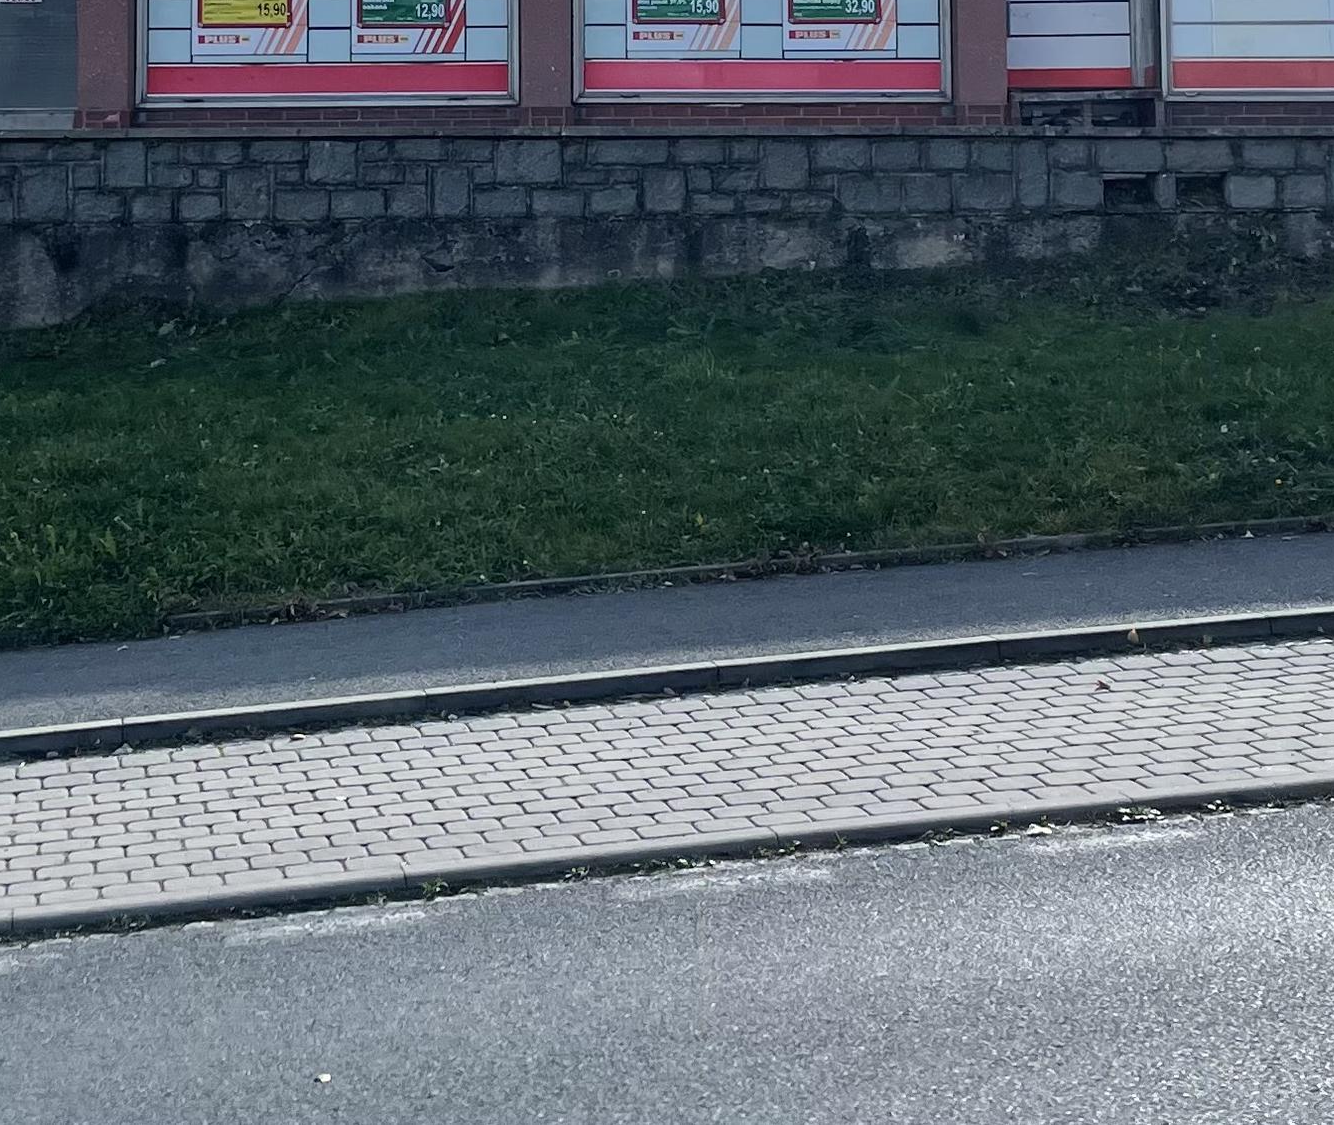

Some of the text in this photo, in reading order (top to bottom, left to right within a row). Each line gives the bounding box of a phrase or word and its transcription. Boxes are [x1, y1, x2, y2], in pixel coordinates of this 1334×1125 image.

[257, 3, 286, 17] 15,90
[415, 3, 445, 20] 12,90
[689, 0, 719, 15] 15,90
[845, 0, 875, 15] 32,90
